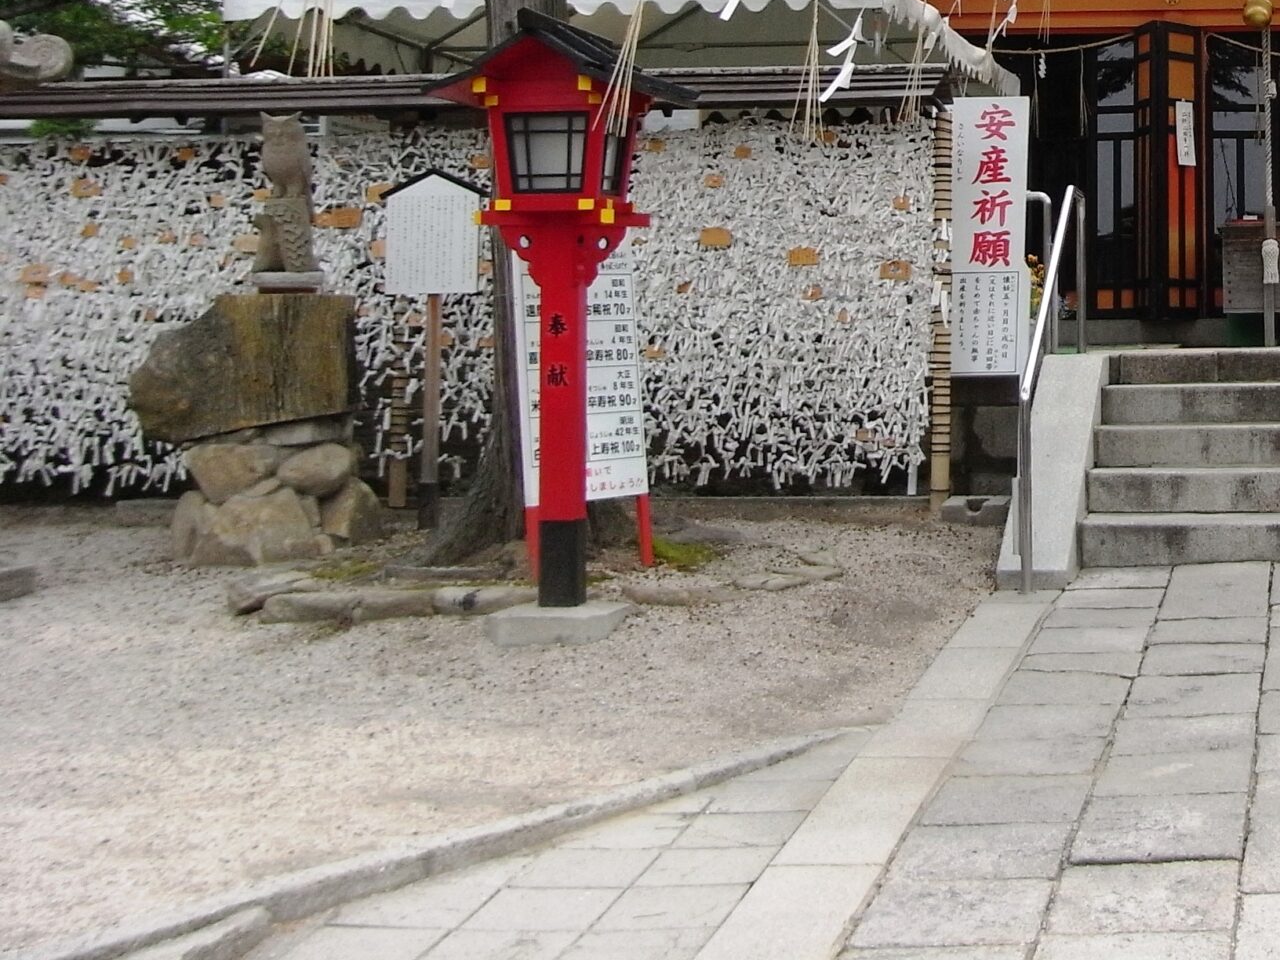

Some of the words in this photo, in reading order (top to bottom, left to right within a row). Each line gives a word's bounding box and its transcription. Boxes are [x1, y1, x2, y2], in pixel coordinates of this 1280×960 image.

[968, 103, 1016, 268] 安産祈願
[604, 290, 628, 299] 14年生
[614, 303, 631, 315] 70才
[611, 336, 632, 344] 4年生
[547, 313, 568, 387] 奉献
[616, 348, 634, 360] 80才
[619, 394, 637, 406] 90才
[615, 427, 639, 437] 42年生
